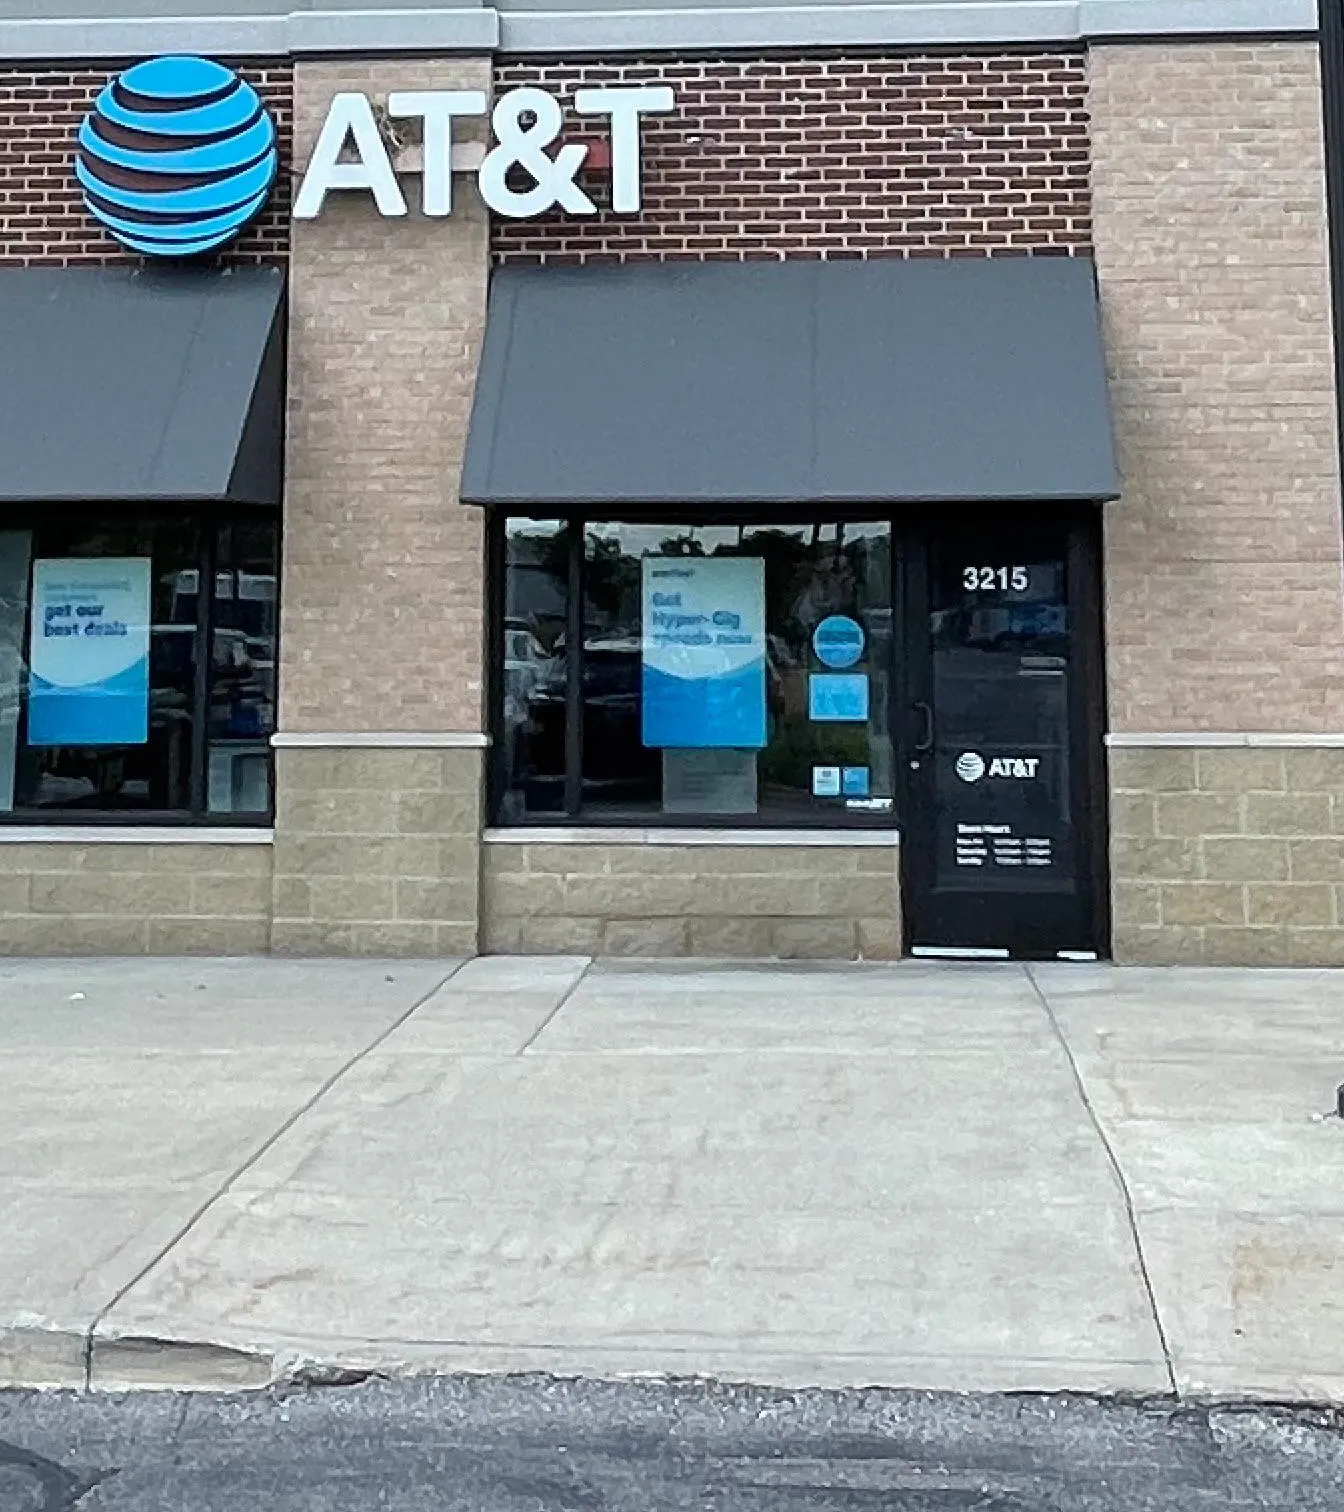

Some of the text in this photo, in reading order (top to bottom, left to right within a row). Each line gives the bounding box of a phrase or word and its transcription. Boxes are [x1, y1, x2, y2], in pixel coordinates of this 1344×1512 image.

[293, 87, 674, 219] AT&T
[963, 567, 1028, 590] 3215
[44, 604, 105, 621] get our
[44, 620, 129, 637] best deals
[988, 758, 1040, 778] AT&T
